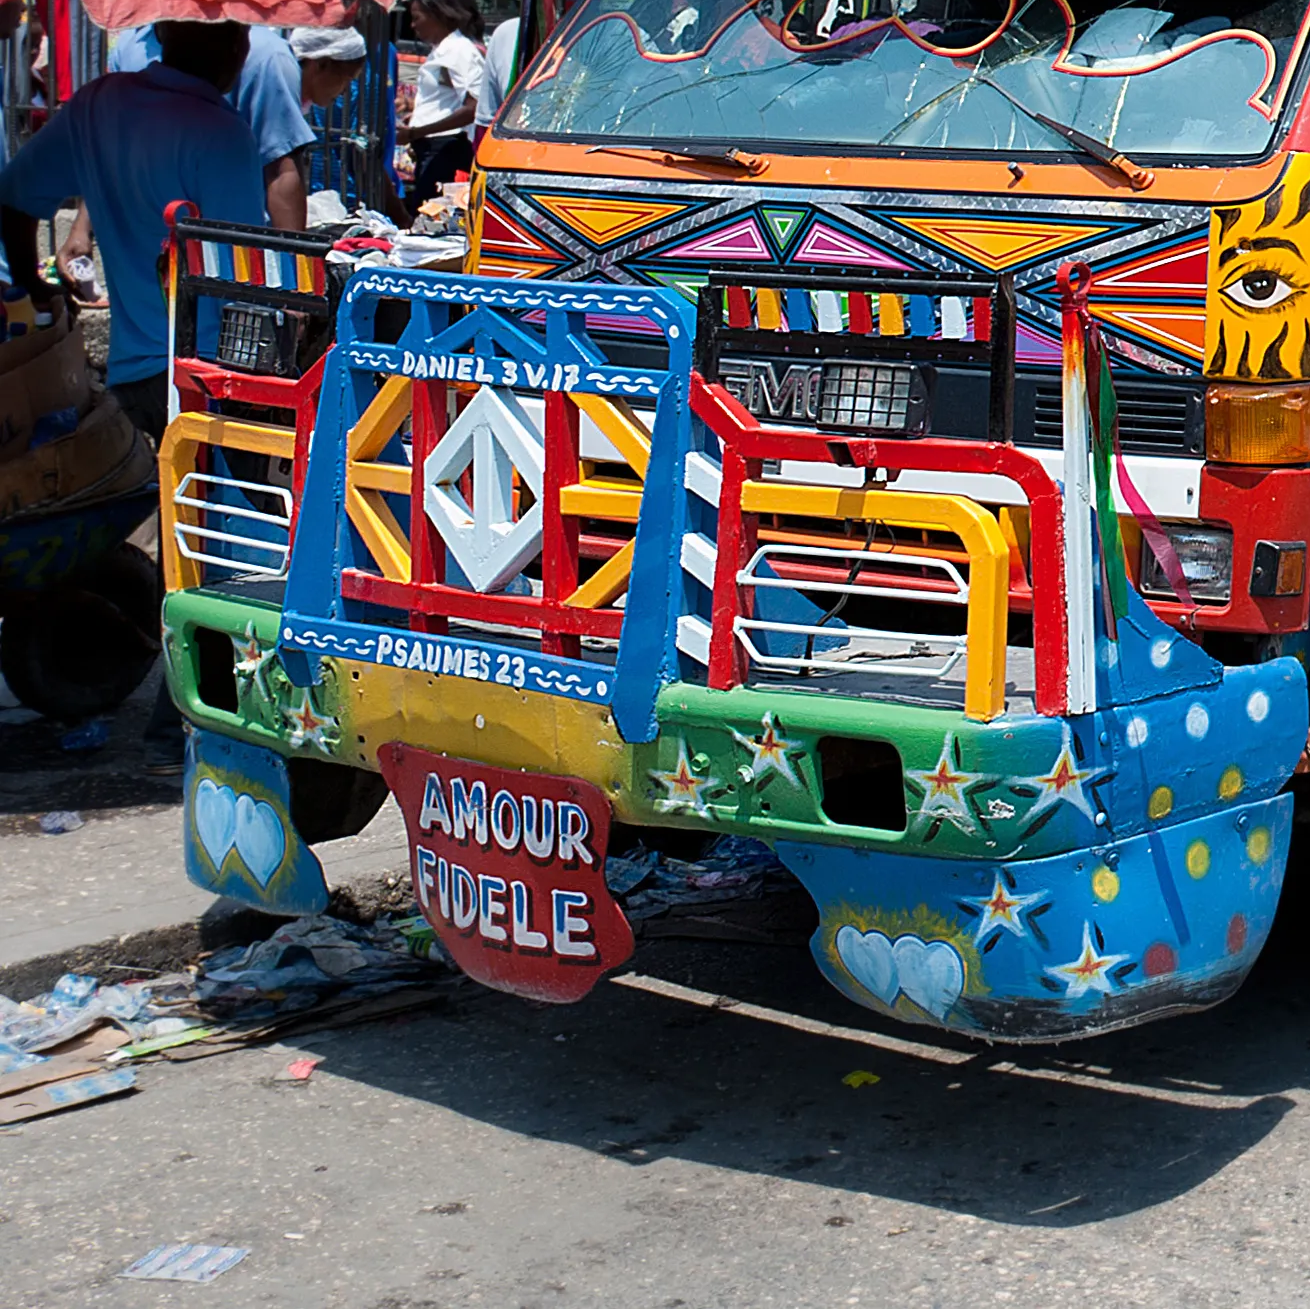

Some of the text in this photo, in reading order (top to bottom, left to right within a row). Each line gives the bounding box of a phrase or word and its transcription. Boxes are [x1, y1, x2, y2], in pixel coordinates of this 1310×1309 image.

[402, 351, 494, 383] DANIEL
[501, 361, 518, 385] 3
[375, 633, 527, 688] PSAUMES 23
[418, 771, 593, 864] AMOUR
[417, 846, 597, 957] FIDELE
